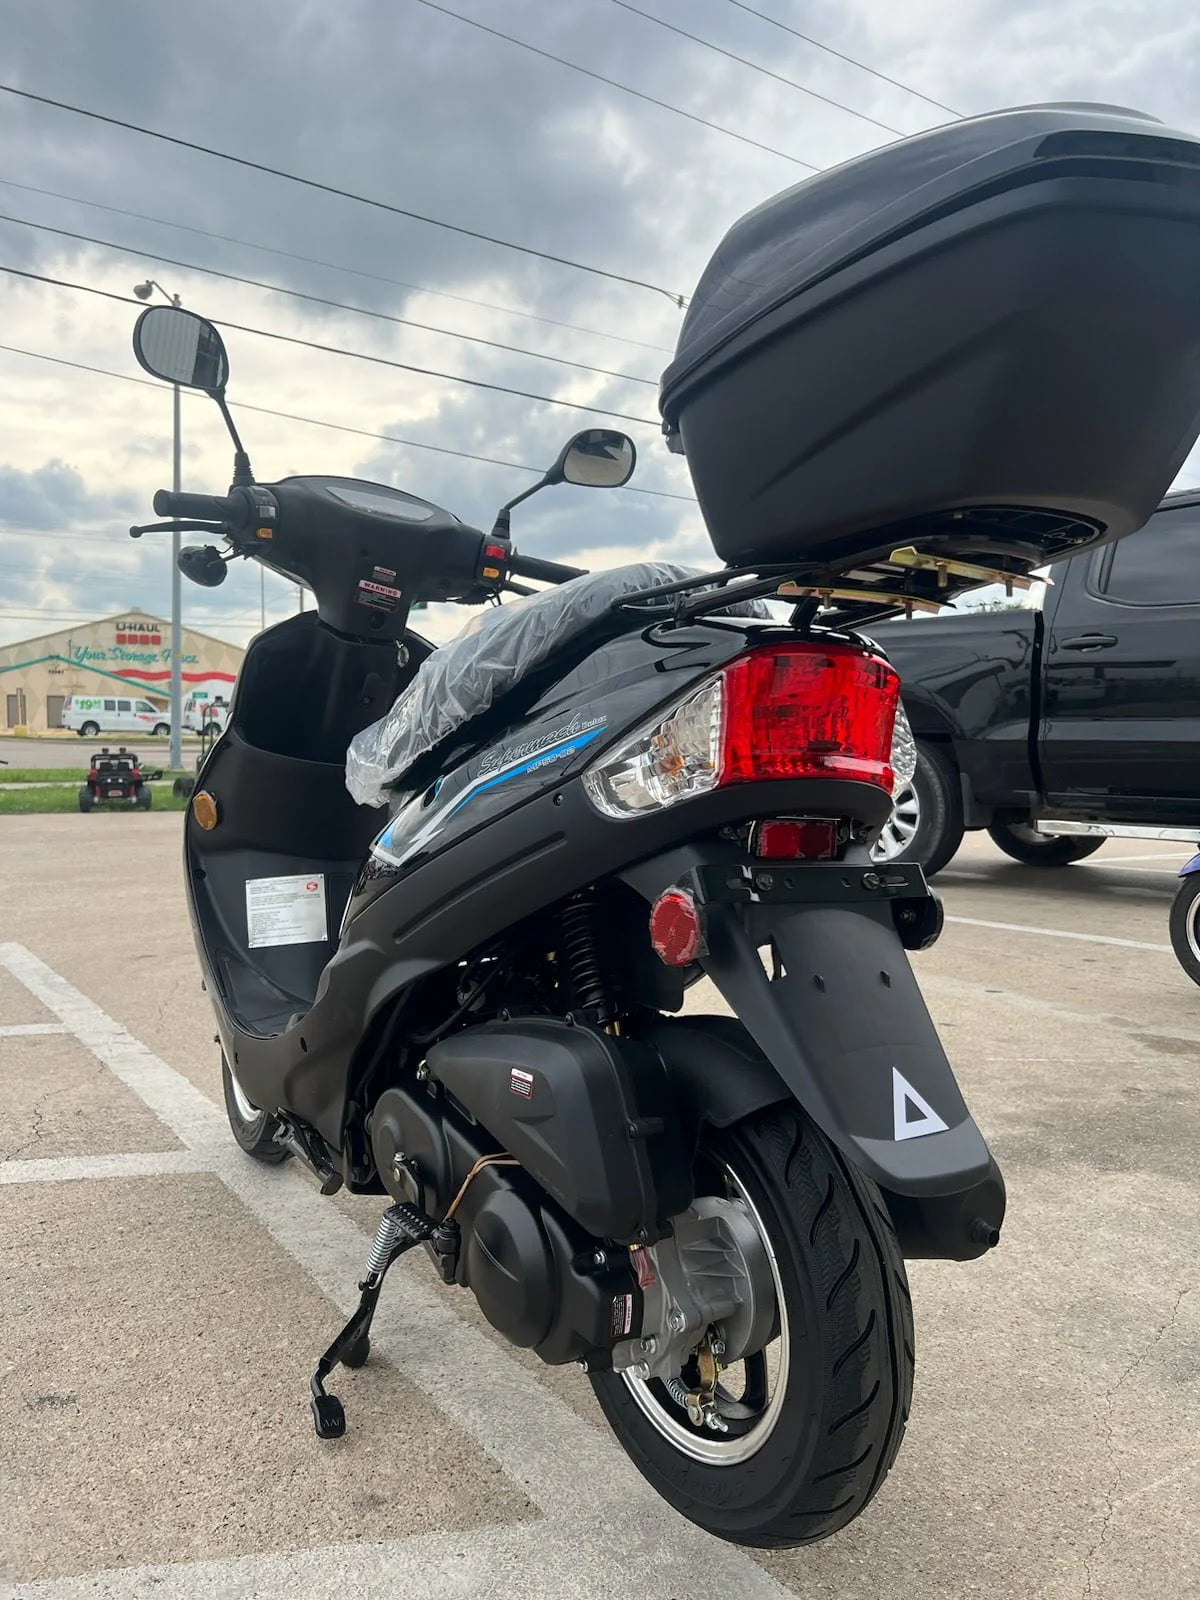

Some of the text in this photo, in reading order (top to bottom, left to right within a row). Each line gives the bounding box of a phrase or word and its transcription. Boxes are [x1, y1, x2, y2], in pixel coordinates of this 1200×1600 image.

[363, 582, 398, 596] WARNING
[74, 646, 199, 665] Your Storage Pace
